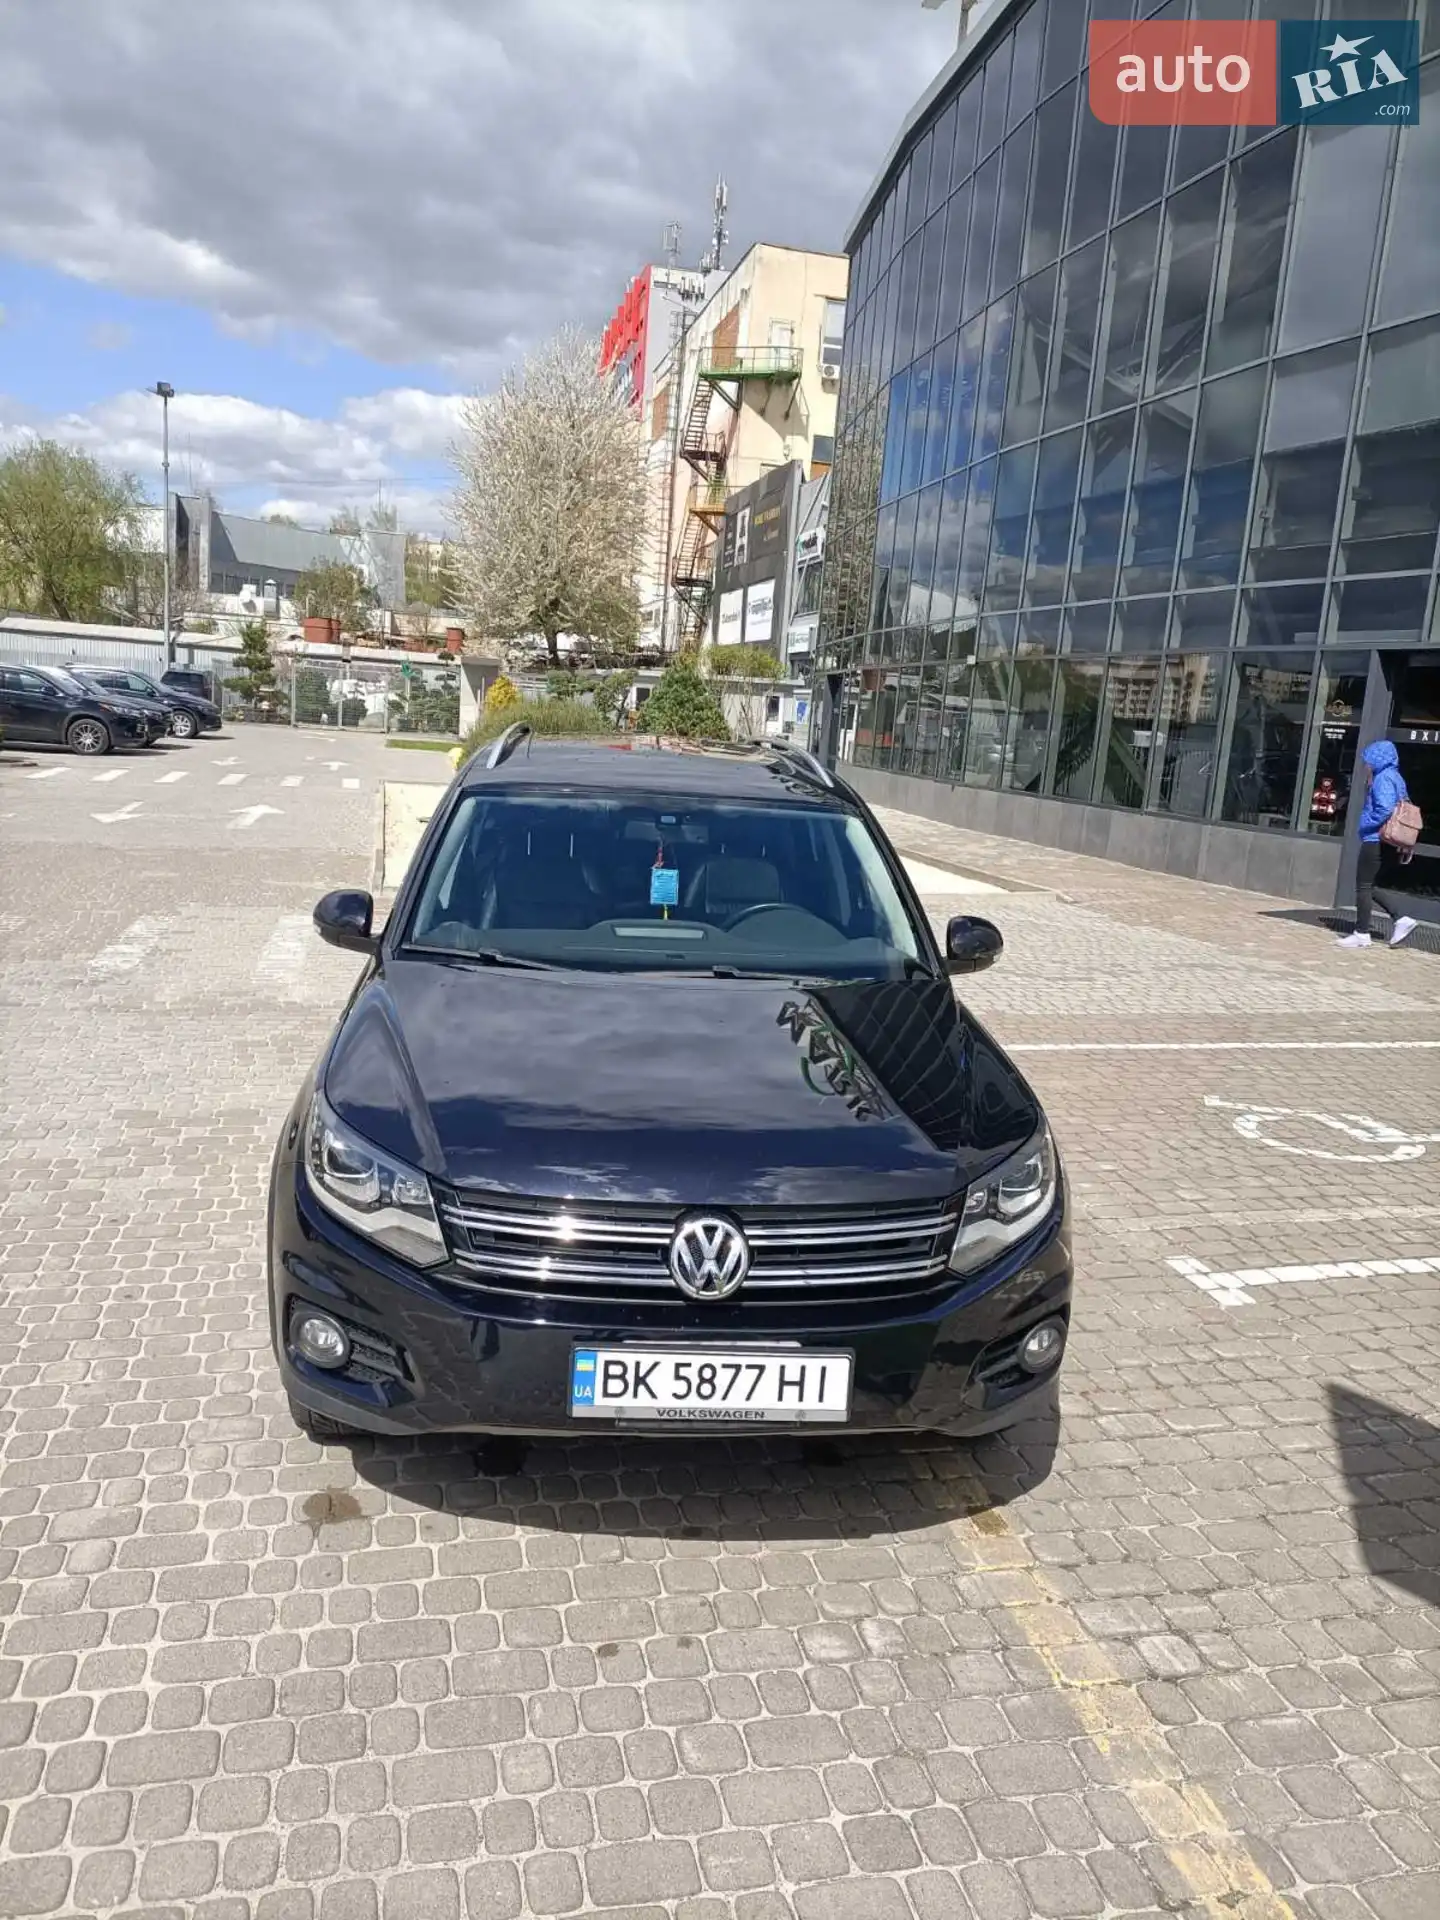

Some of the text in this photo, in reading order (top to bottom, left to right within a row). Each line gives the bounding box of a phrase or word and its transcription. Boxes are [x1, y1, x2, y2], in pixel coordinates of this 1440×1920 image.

[574, 1359, 827, 1402] UA BK 5877 HI
[656, 1409, 765, 1420] VOLKSWAGEN
